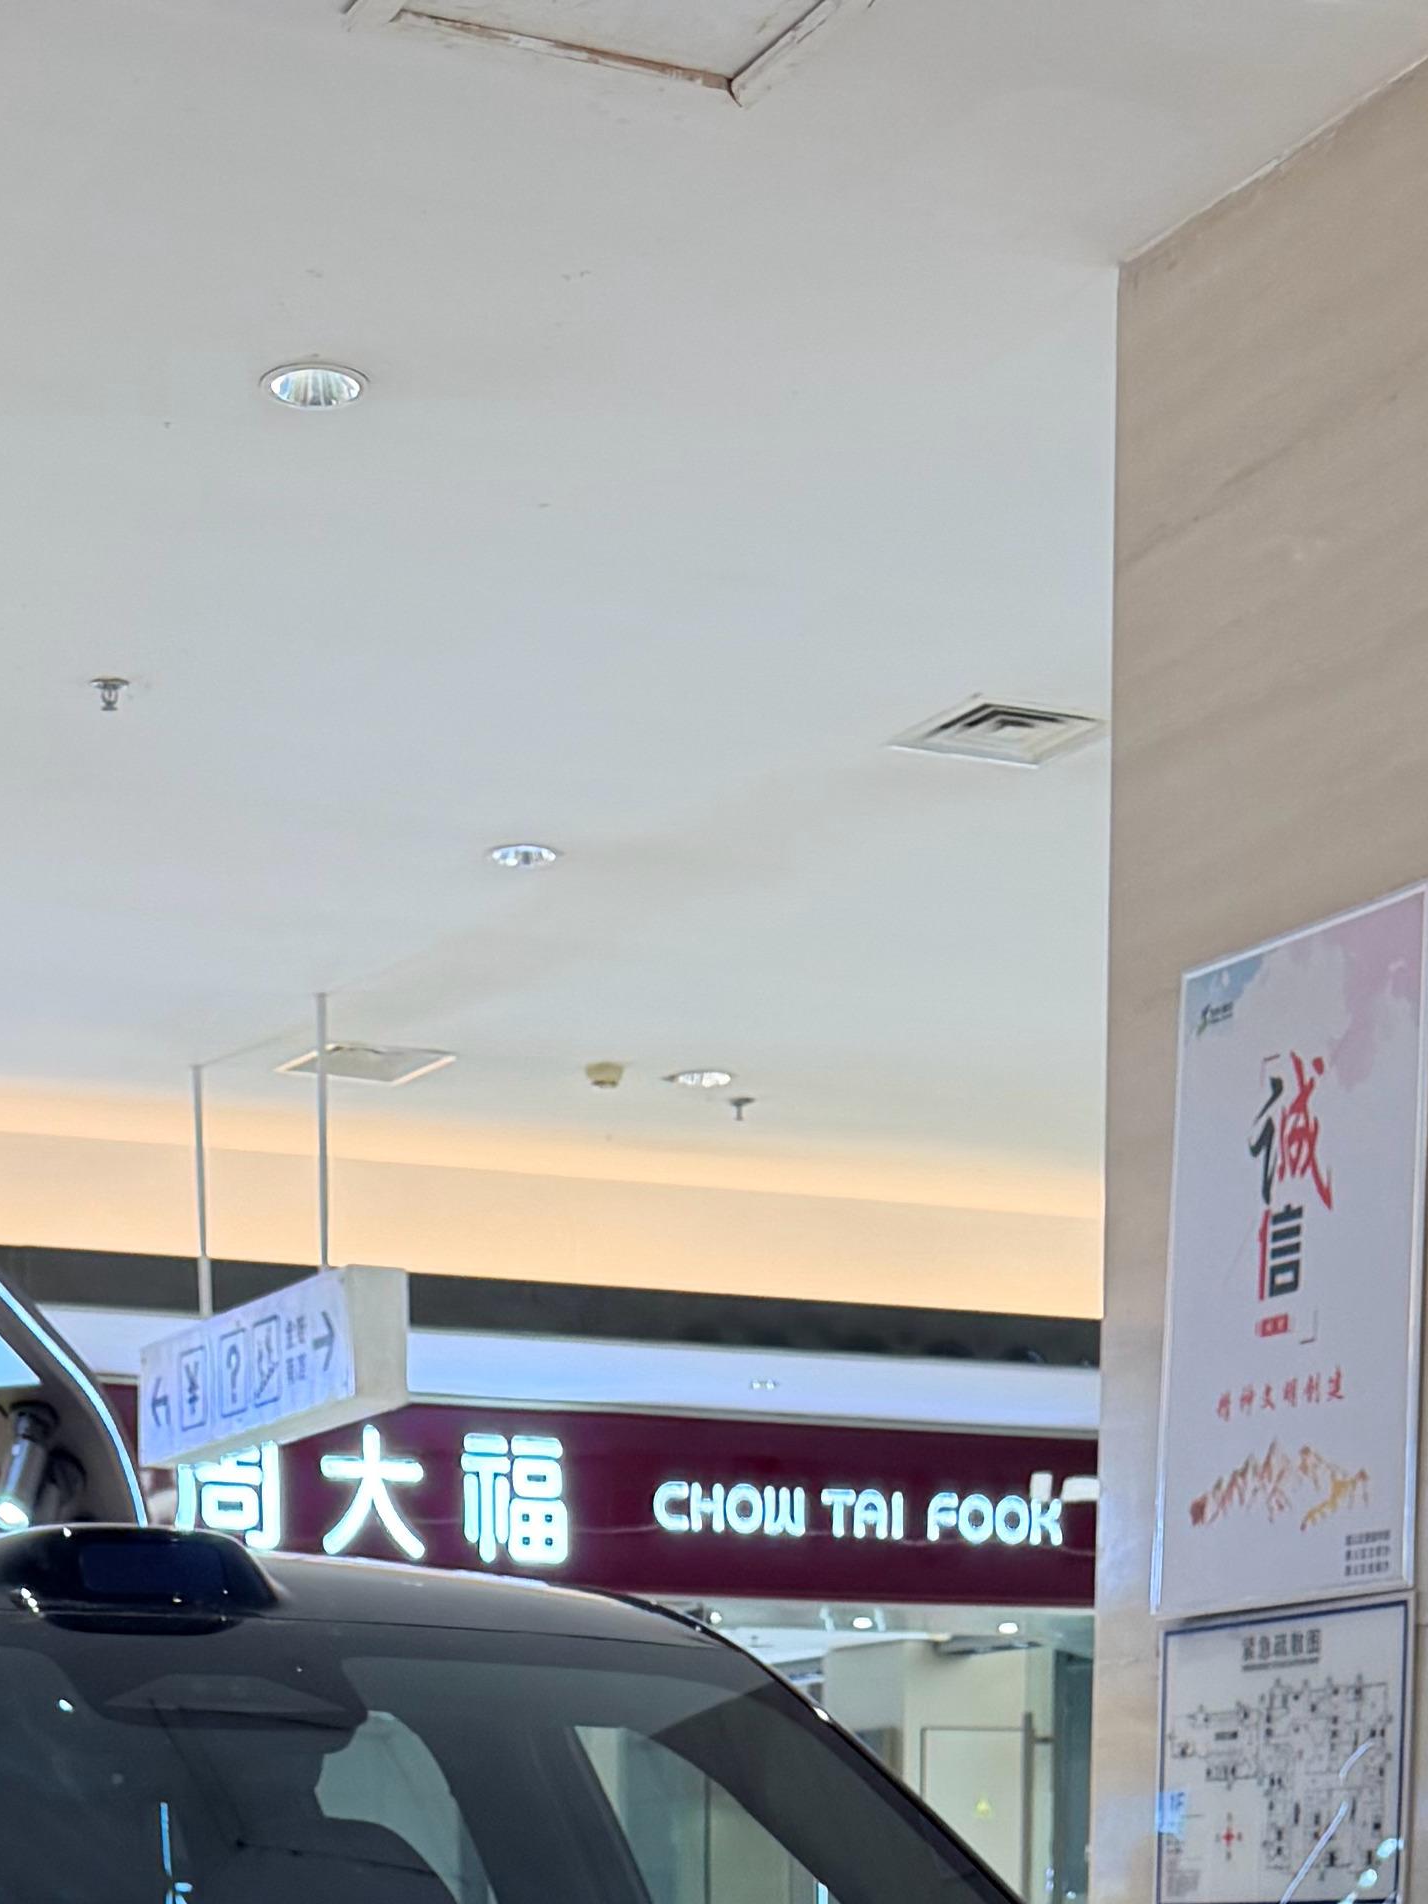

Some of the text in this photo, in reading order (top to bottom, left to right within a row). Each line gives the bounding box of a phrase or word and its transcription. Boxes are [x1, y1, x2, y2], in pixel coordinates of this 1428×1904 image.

[1248, 1050, 1333, 1301] 诚信
[653, 1481, 1064, 1547] CHOW TAI FOOK
